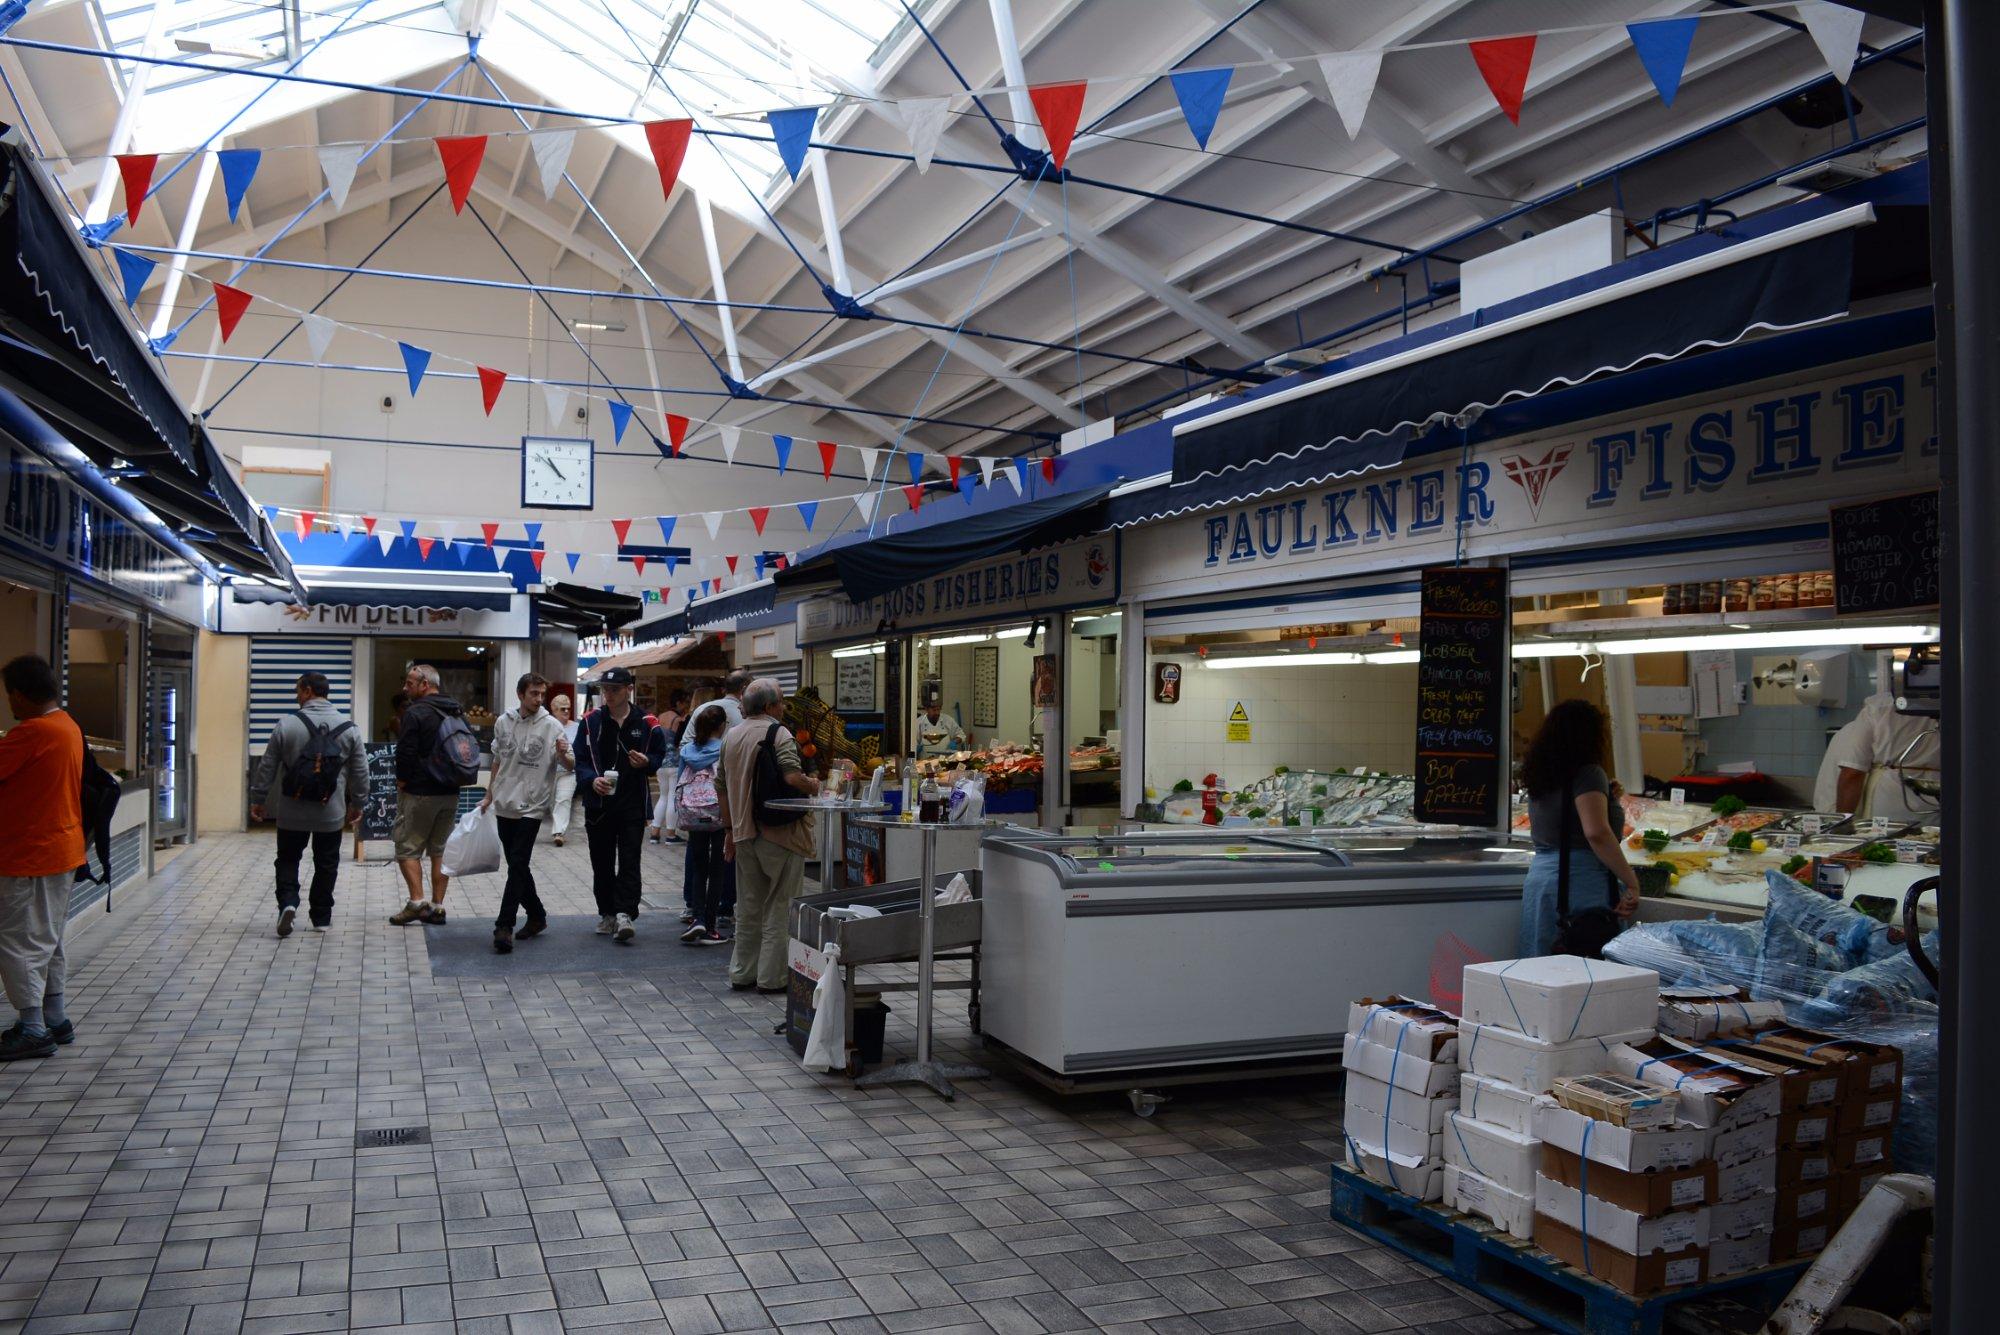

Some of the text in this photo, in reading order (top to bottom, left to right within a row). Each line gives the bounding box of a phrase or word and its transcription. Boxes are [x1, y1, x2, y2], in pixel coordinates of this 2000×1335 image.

[1204, 461, 1495, 568] FAULKNER
[1836, 534, 1893, 555] HOMARD
[1844, 552, 1902, 572] LOBSTER
[1854, 568, 1887, 582] SOUP
[834, 552, 1060, 628] DUNN-ROSS FISHERIES
[1840, 582, 1896, 607] £6.70
[318, 604, 357, 623] FM
[1424, 643, 1481, 663] LOBSTER
